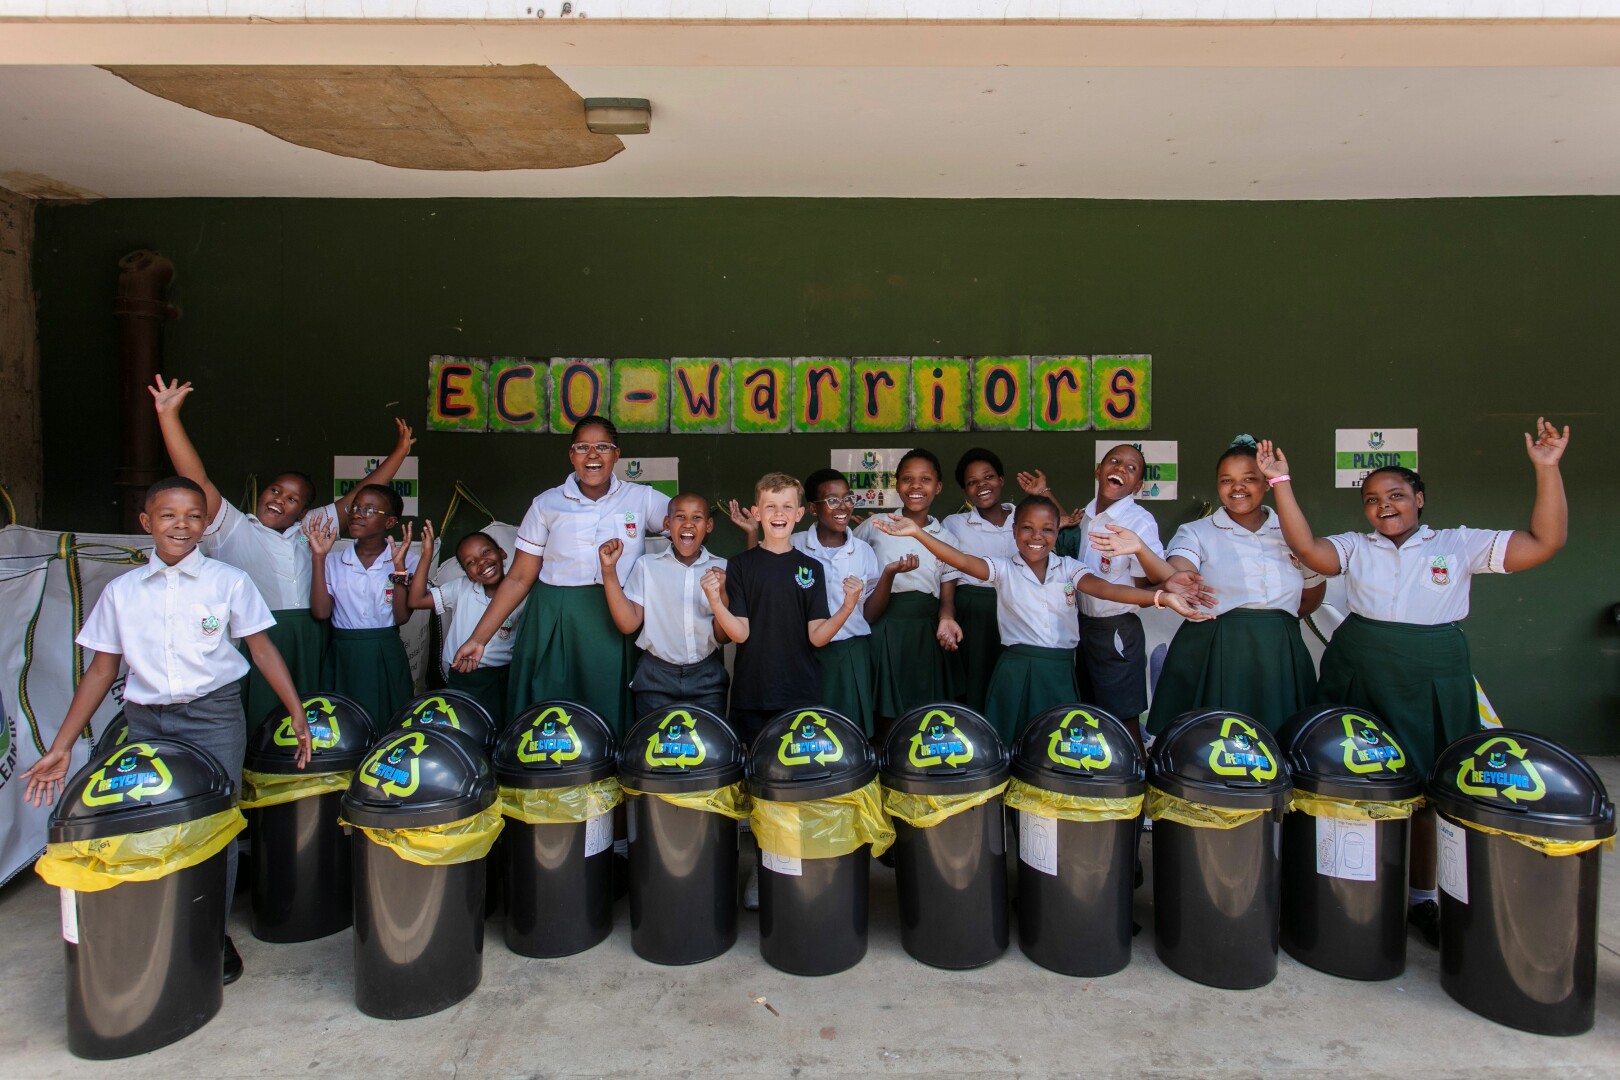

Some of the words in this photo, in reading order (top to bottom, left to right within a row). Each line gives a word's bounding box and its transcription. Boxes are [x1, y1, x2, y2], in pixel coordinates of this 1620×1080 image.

[1353, 452, 1401, 469] PLASTIC
[529, 738, 572, 752] RECYCLING
[654, 742, 696, 755] RECYCLING
[790, 740, 833, 754] RECYCLING
[920, 741, 963, 756] RECYCLING
[0, 742, 17, 789] EAN
[1224, 752, 1269, 768] RECYCLING
[369, 761, 410, 784] RECYCLING
[1472, 771, 1530, 789] RECYCLING
[98, 772, 157, 792] RECYCLING
